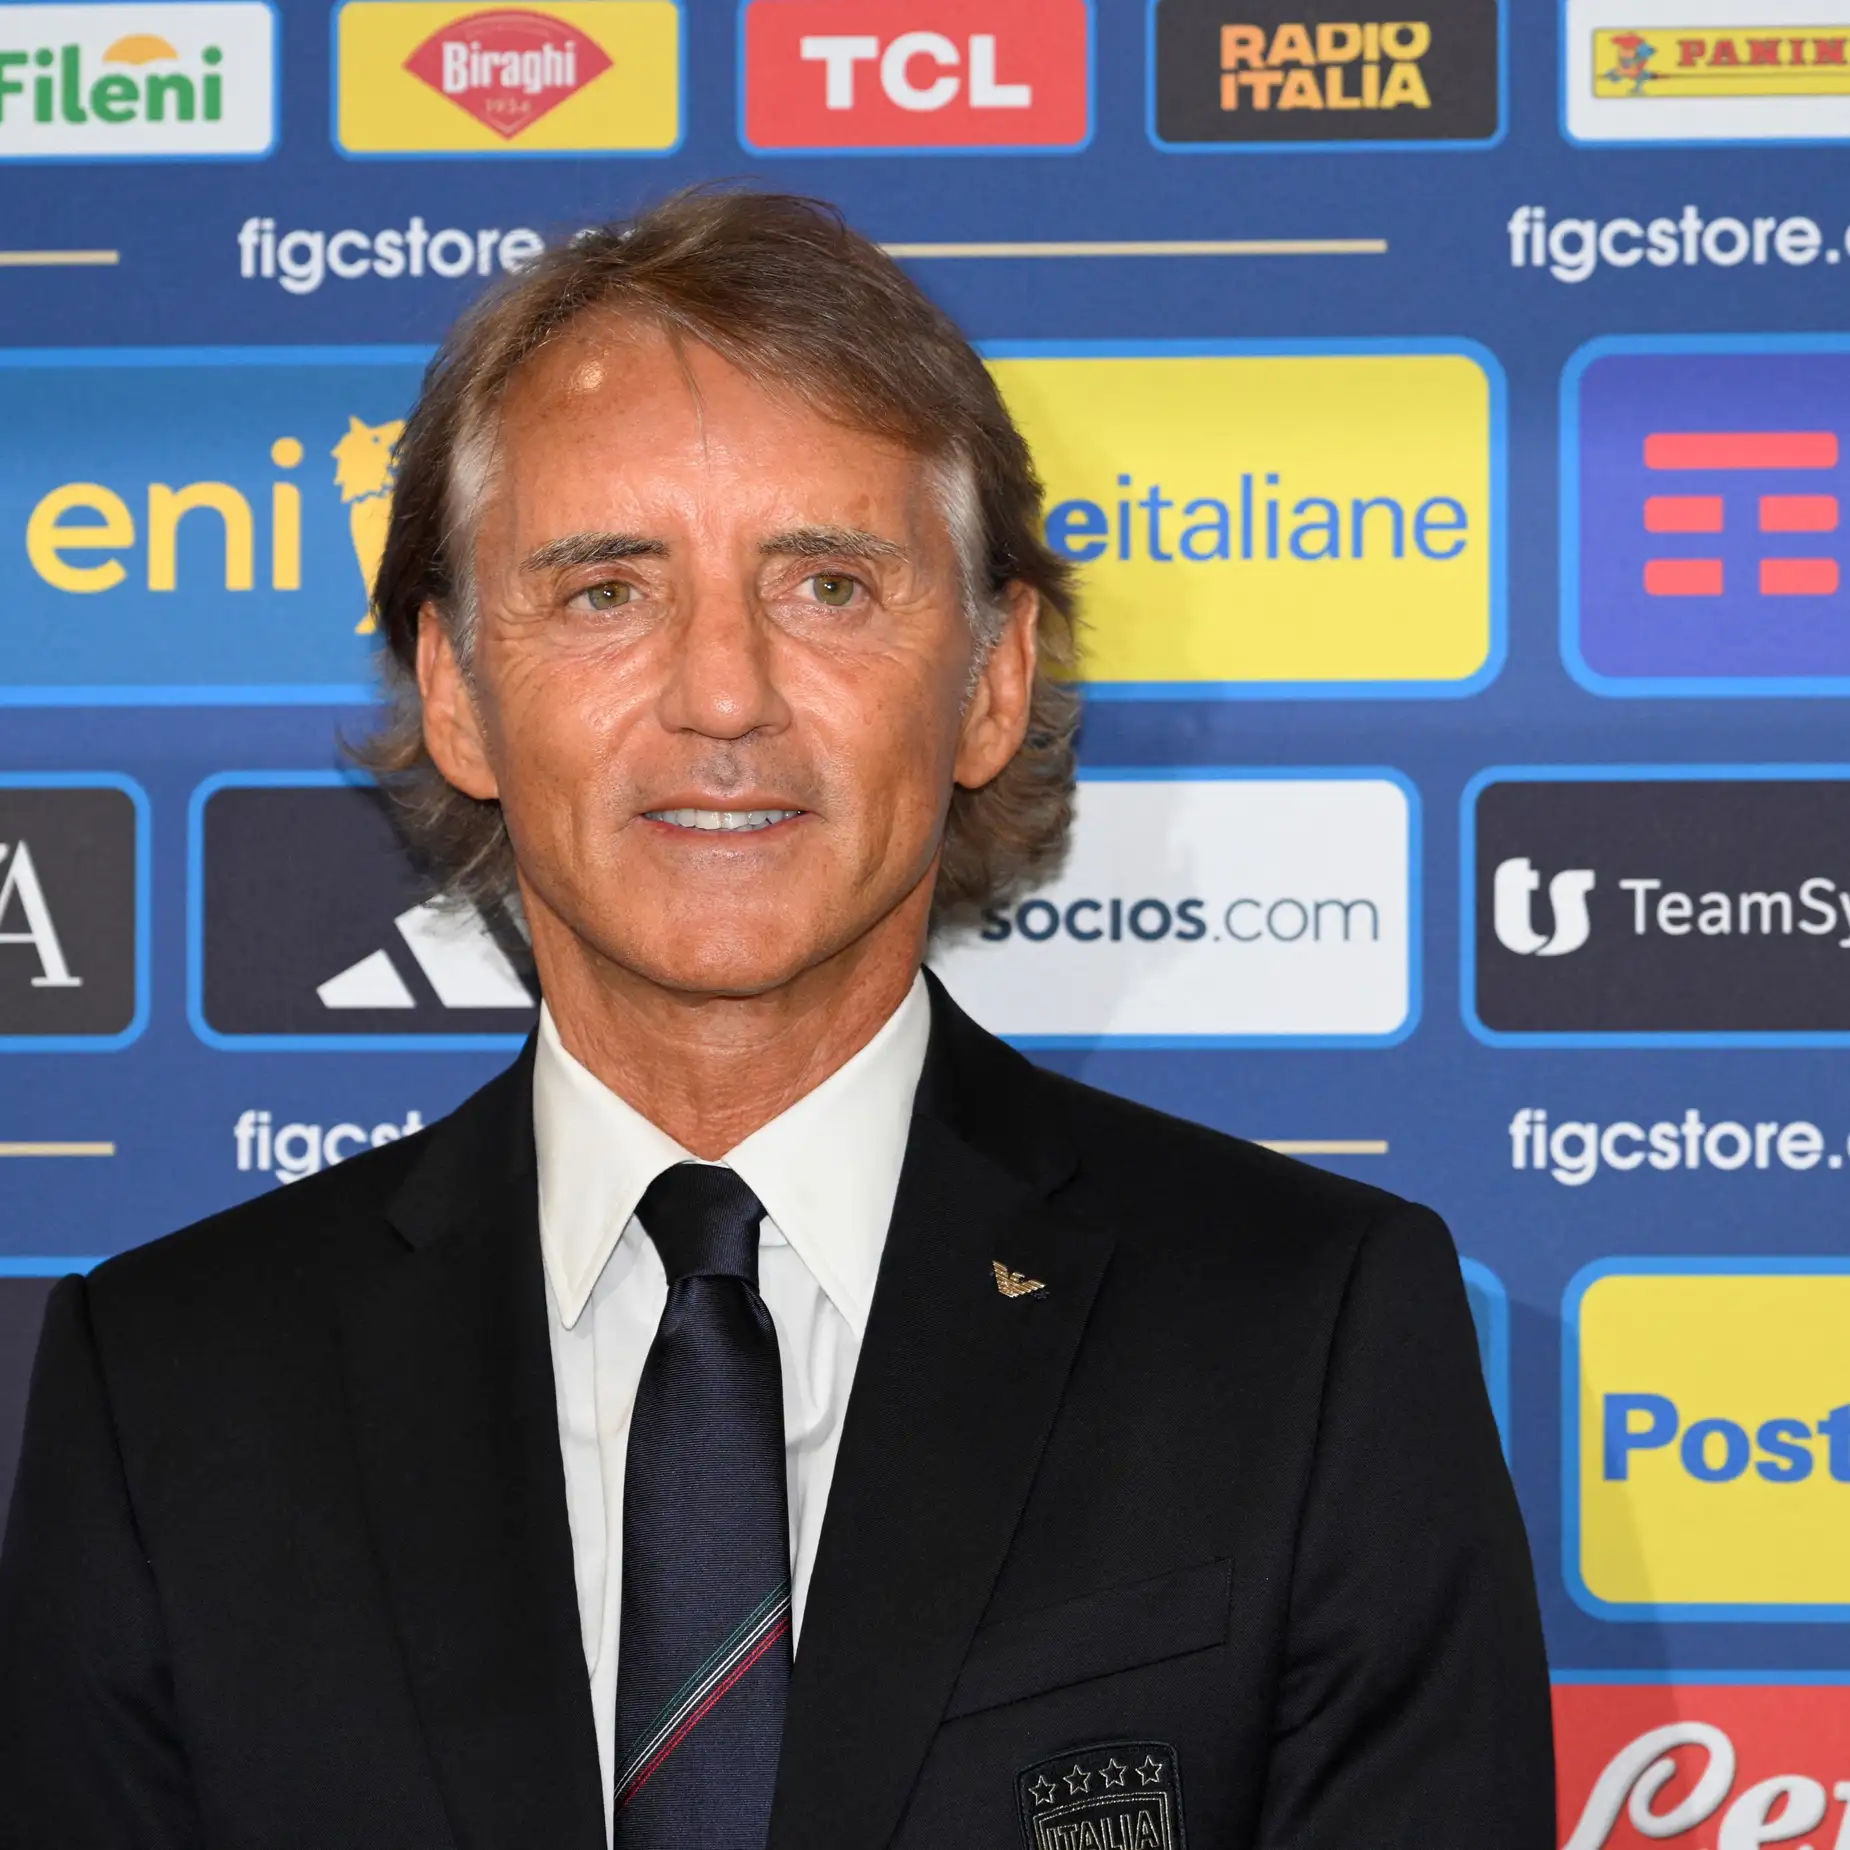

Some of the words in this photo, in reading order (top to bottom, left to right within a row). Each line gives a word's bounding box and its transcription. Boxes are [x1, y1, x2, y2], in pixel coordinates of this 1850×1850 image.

[0, 44, 223, 124] Fileni
[442, 40, 577, 94] Biraghi
[801, 32, 1031, 111] TCL
[1220, 21, 1432, 70] RADIO
[1676, 37, 1848, 68] PANIN
[1220, 62, 1432, 111] ITALIA
[237, 216, 637, 294] figcstore
[1507, 205, 1850, 283] figcstore.
[26, 436, 304, 594] eni
[1509, 1108, 1850, 1186] figcstore.
[1602, 1393, 1850, 1483] Post
[1046, 1810, 1160, 1850] ITALIA
